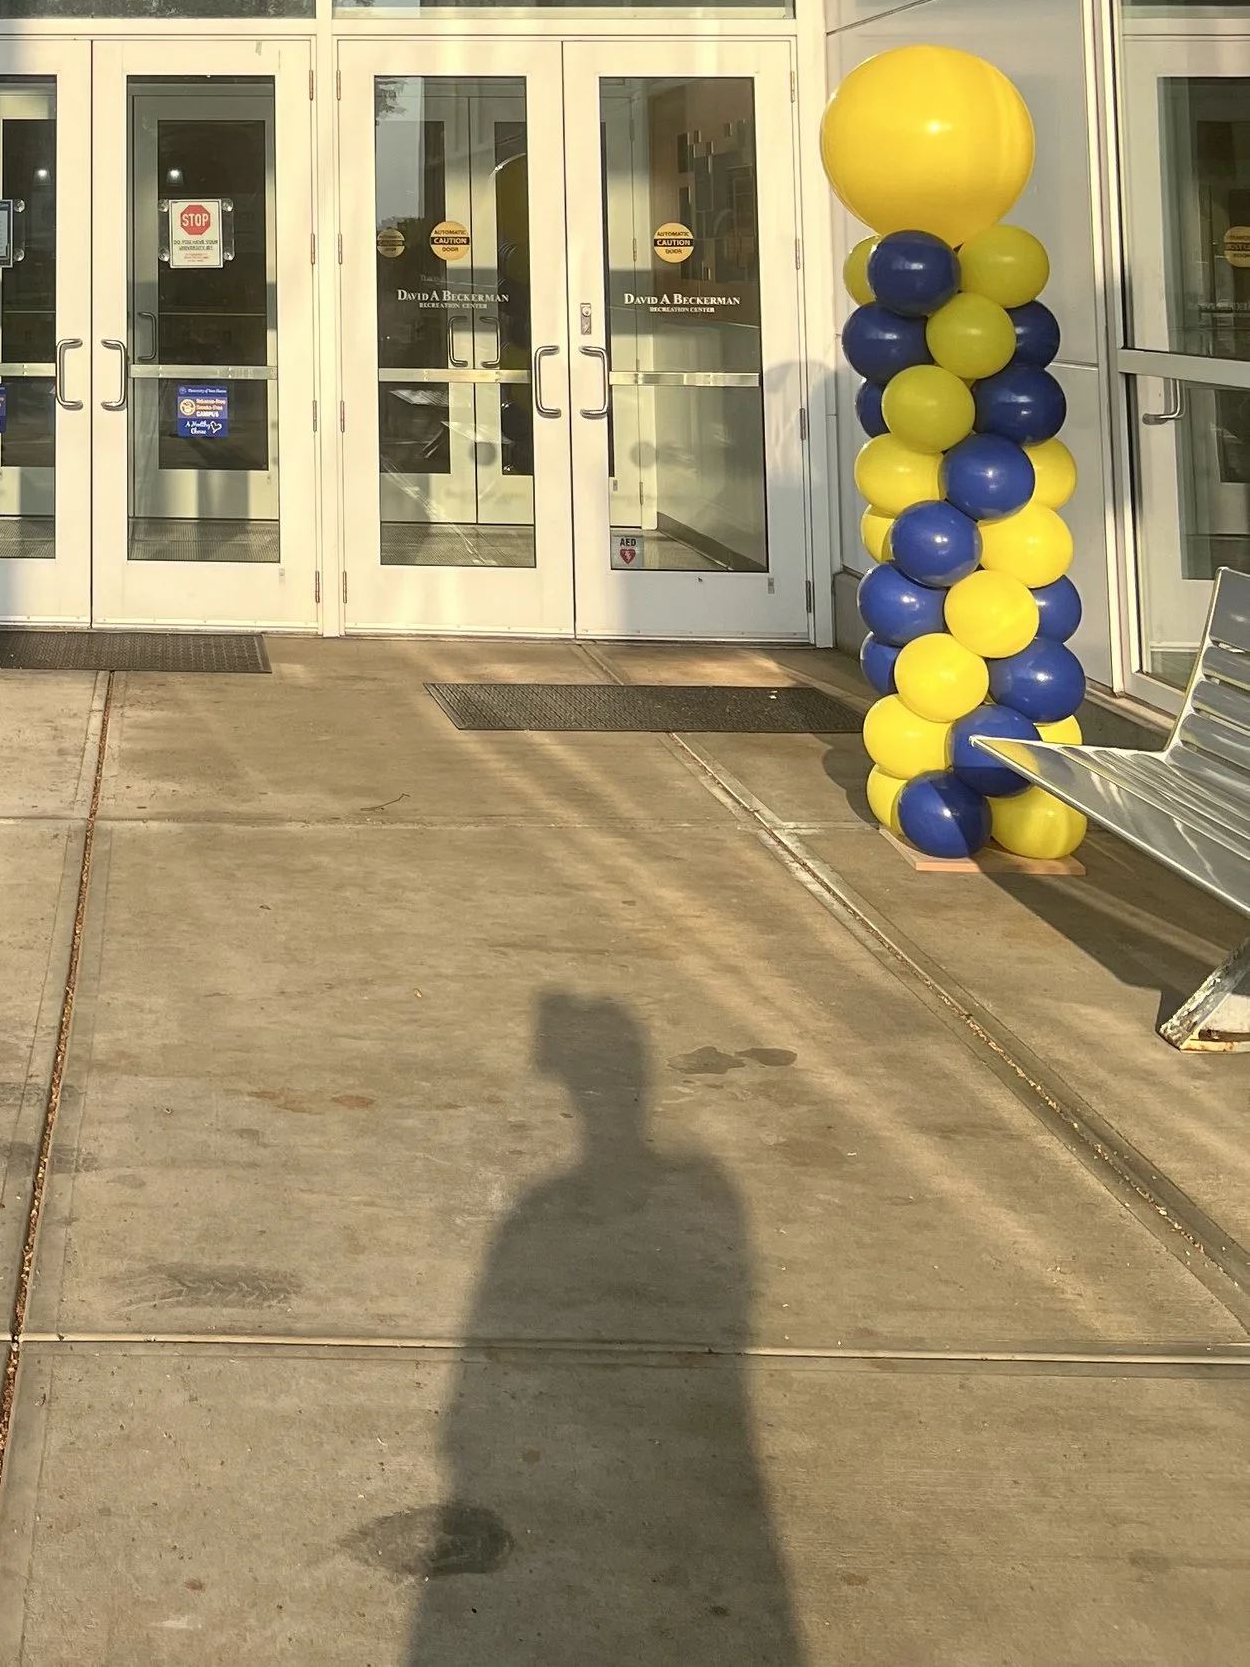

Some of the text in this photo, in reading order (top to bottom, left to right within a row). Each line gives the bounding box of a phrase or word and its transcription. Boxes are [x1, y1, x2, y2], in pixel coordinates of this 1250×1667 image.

[182, 214, 209, 227] STOP
[397, 289, 510, 302] DAVID A BECKERMAN
[624, 293, 741, 305] DAVID A BECKERMAN
[620, 538, 636, 546] AED
